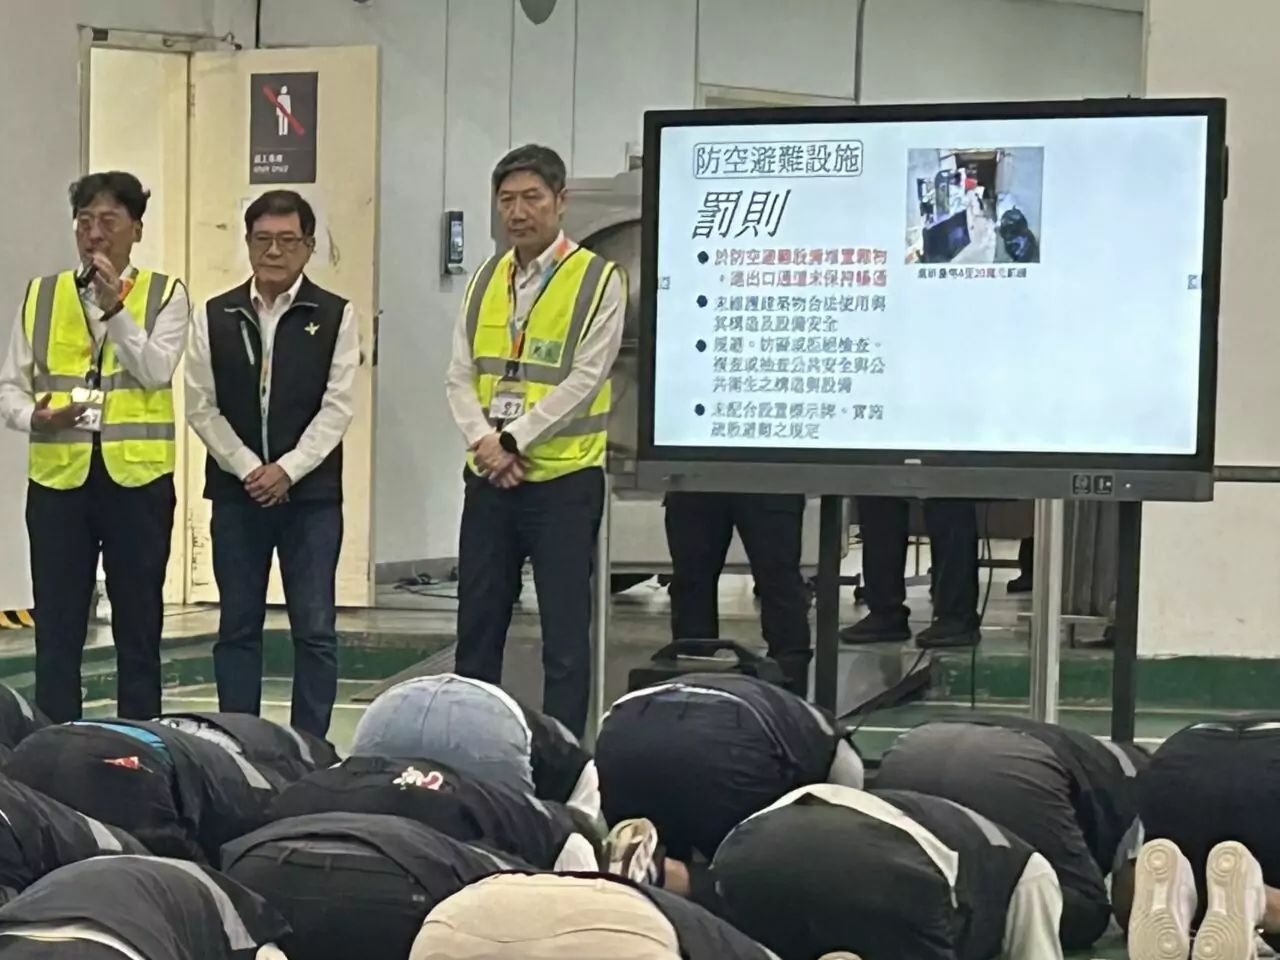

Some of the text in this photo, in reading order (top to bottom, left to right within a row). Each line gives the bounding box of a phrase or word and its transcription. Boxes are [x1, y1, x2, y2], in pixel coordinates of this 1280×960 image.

[696, 144, 860, 175] 防空避難設施
[692, 189, 792, 239] 罰則
